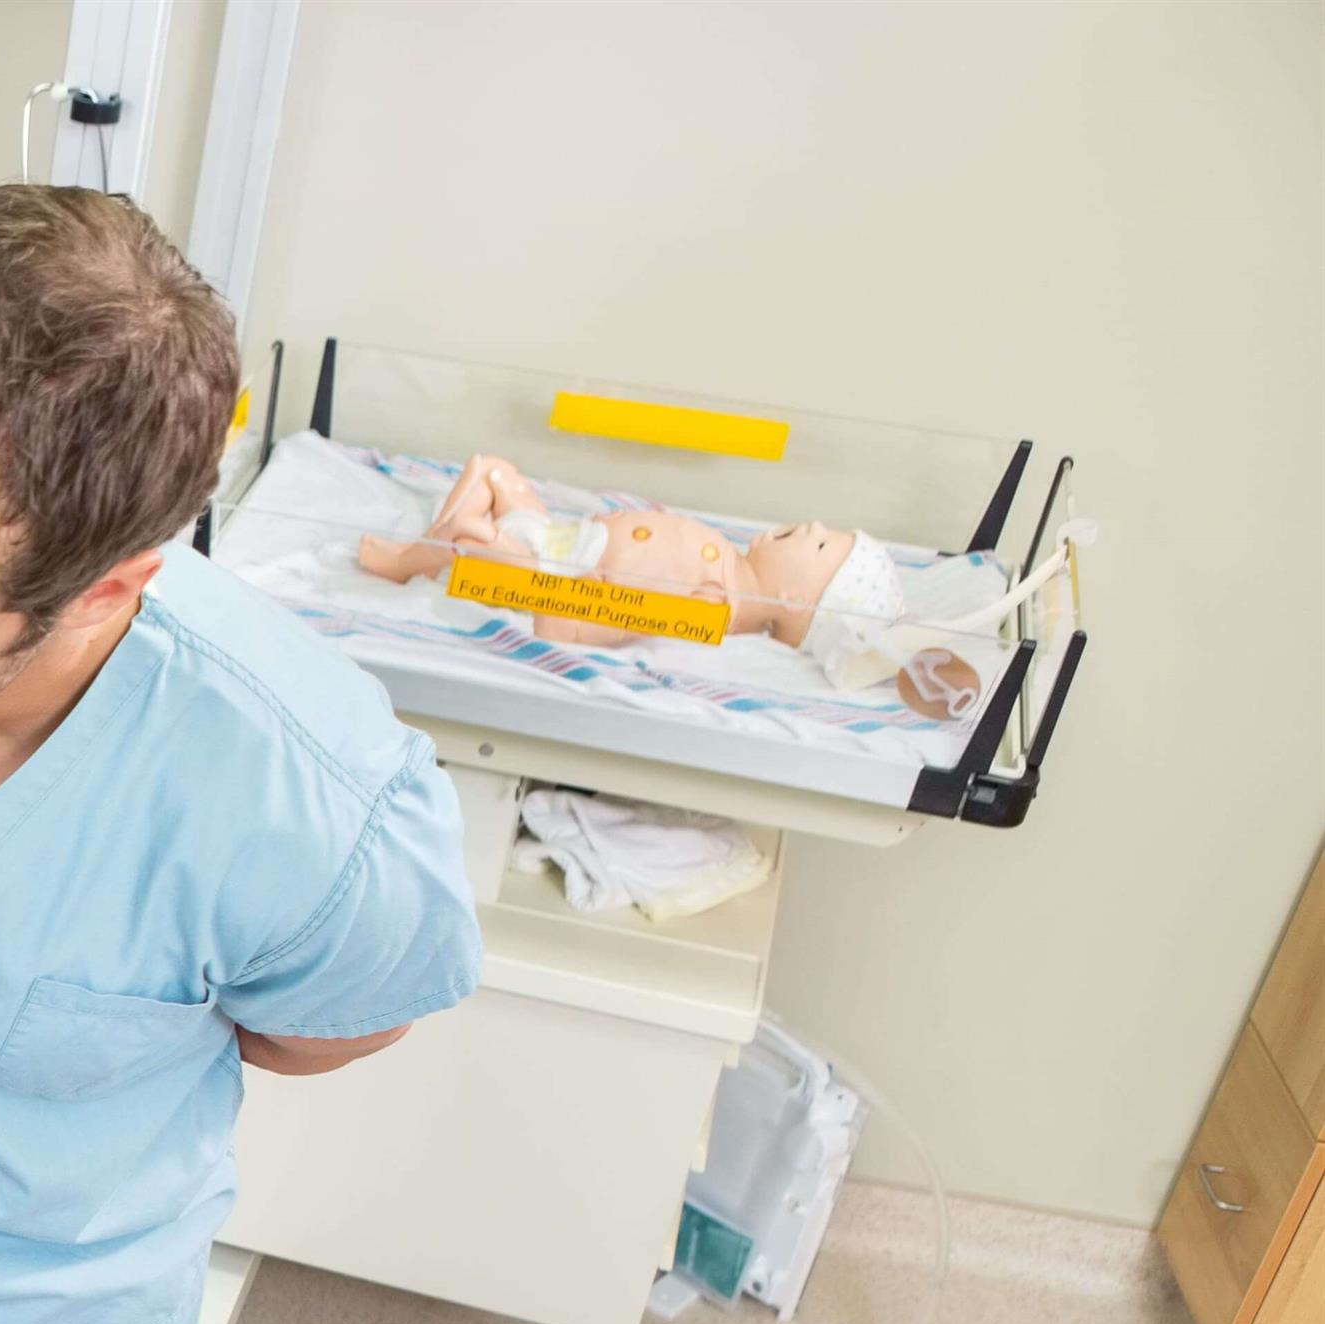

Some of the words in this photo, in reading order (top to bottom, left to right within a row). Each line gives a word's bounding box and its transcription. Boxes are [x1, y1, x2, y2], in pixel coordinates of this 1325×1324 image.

[458, 579, 486, 597] For
[491, 586, 592, 617] Educational
[596, 605, 667, 631] Purpose
[674, 620, 714, 642] Only
[530, 572, 563, 590] NB!
[570, 579, 603, 599] This
[609, 587, 644, 606] Unit
